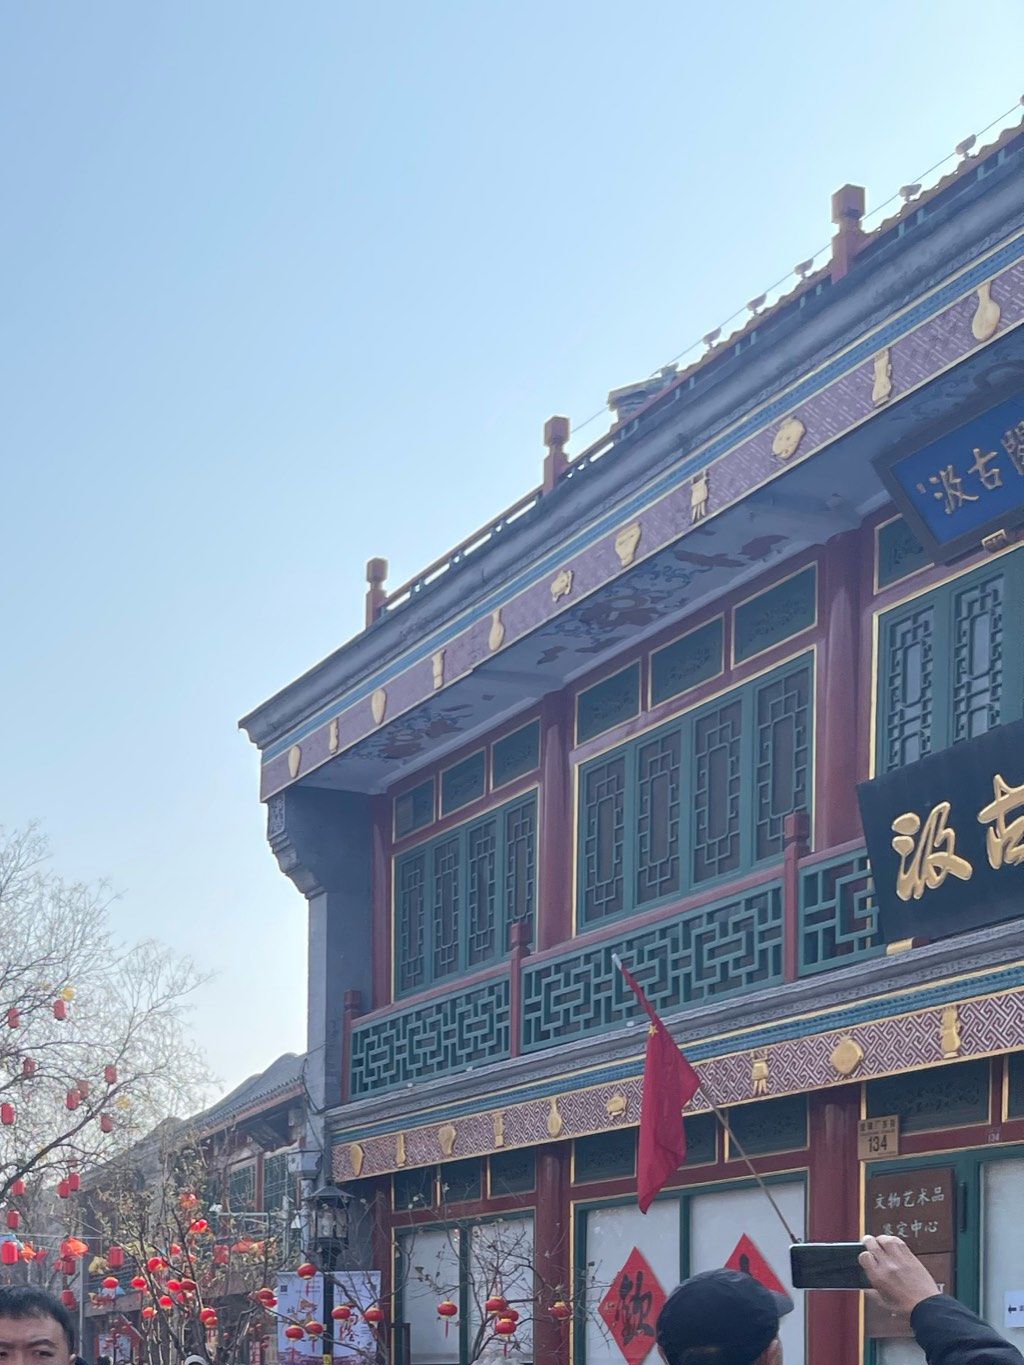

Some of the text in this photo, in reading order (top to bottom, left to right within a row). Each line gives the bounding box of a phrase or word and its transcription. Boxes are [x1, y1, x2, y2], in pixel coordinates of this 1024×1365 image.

[868, 1135, 887, 1152] 134
[874, 1186, 945, 1209] 文物艺术品
